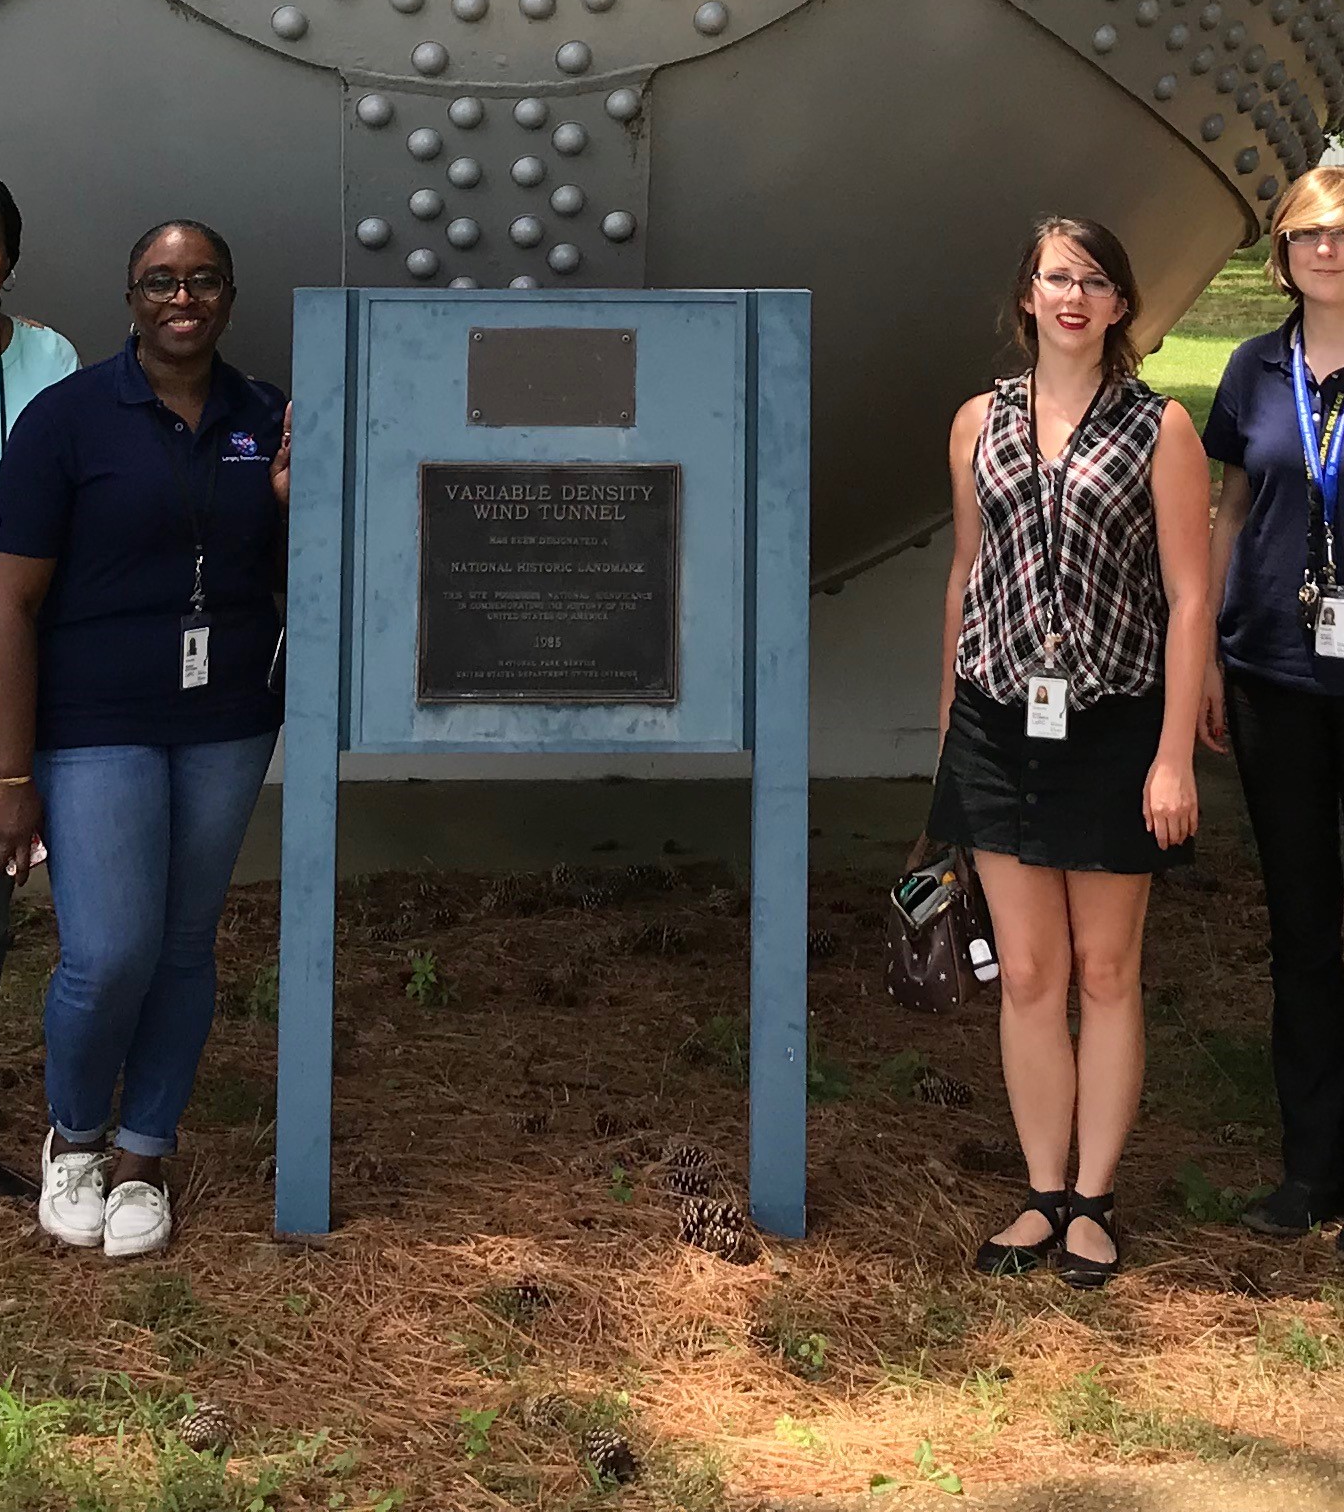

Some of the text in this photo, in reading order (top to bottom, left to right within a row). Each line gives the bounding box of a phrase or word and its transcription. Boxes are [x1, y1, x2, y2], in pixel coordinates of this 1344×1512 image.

[445, 485, 654, 501] VARIABLE DENSITY
[473, 505, 626, 521] WIND TUNNEL
[451, 562, 645, 573] NATIONAL HISTORIC LANDMARK
